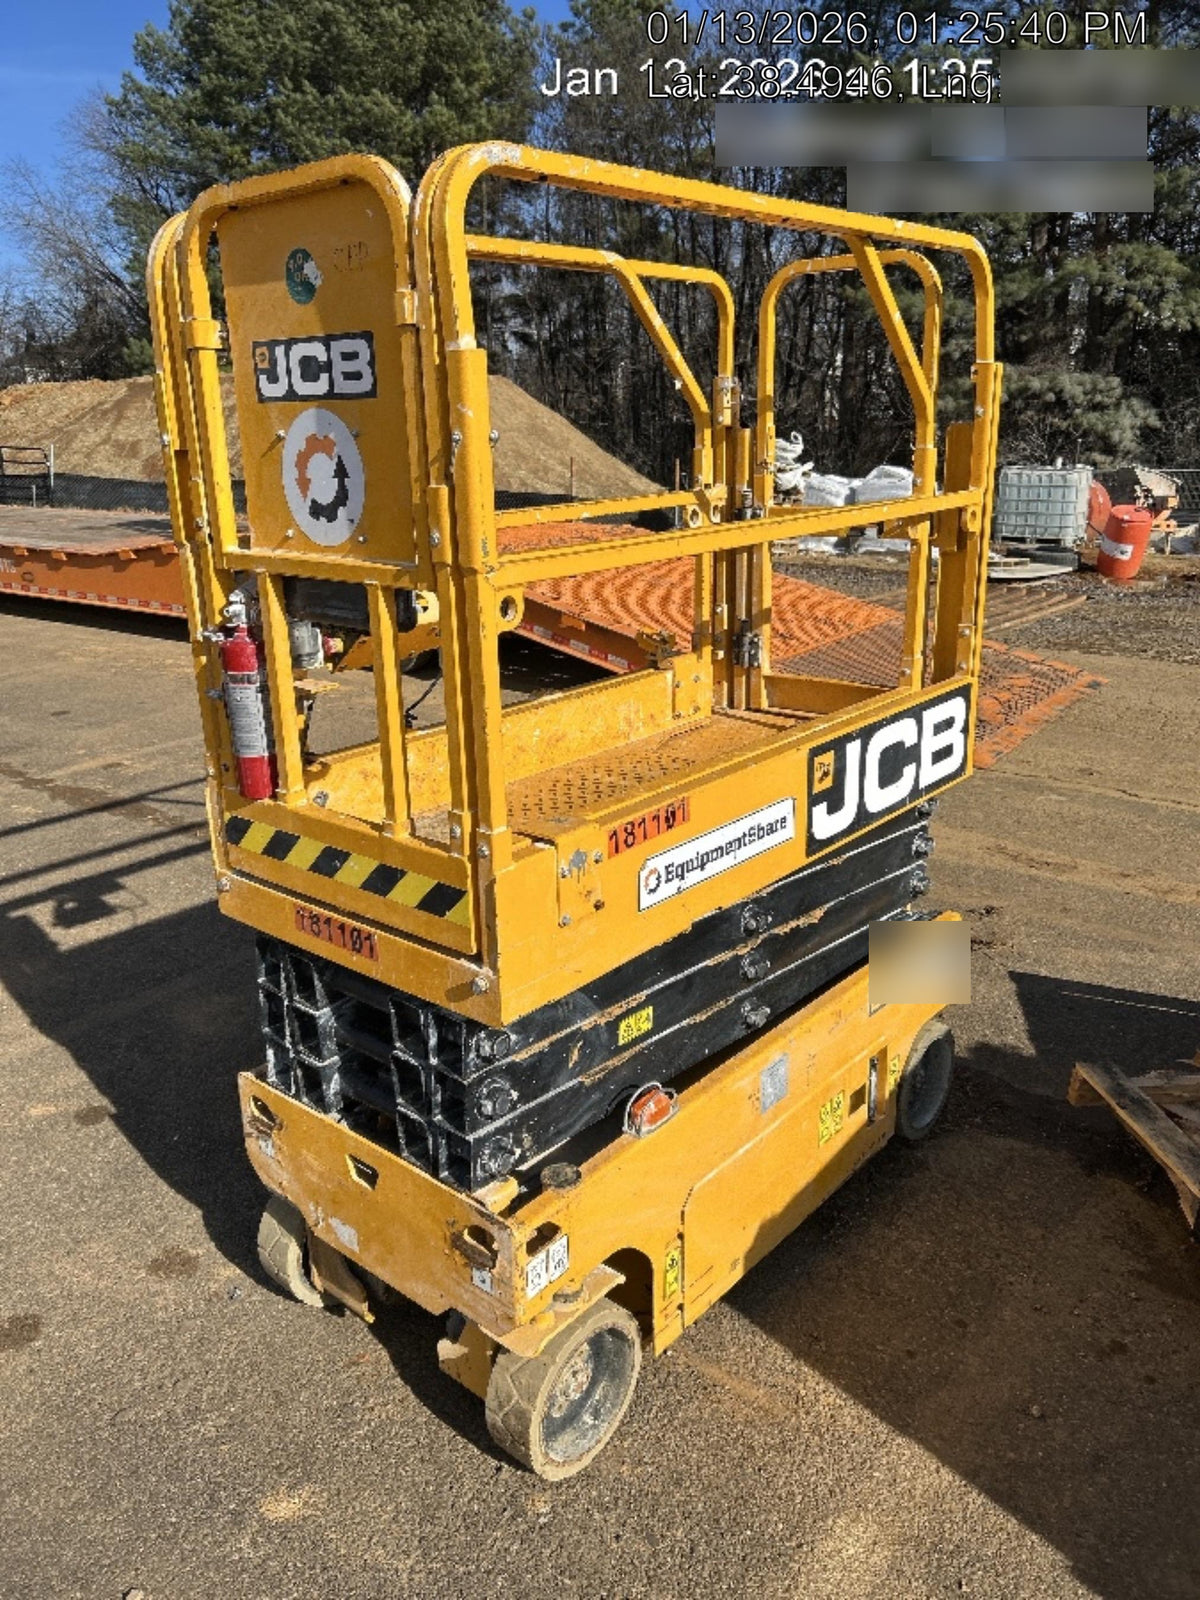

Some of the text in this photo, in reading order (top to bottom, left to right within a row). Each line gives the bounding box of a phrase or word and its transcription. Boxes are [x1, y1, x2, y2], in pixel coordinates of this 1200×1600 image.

[259, 339, 374, 397] JCB
[811, 696, 966, 840] JCB
[609, 797, 686, 855] 181101
[664, 814, 787, 885] EquipmentShare
[296, 906, 375, 959] 181101
